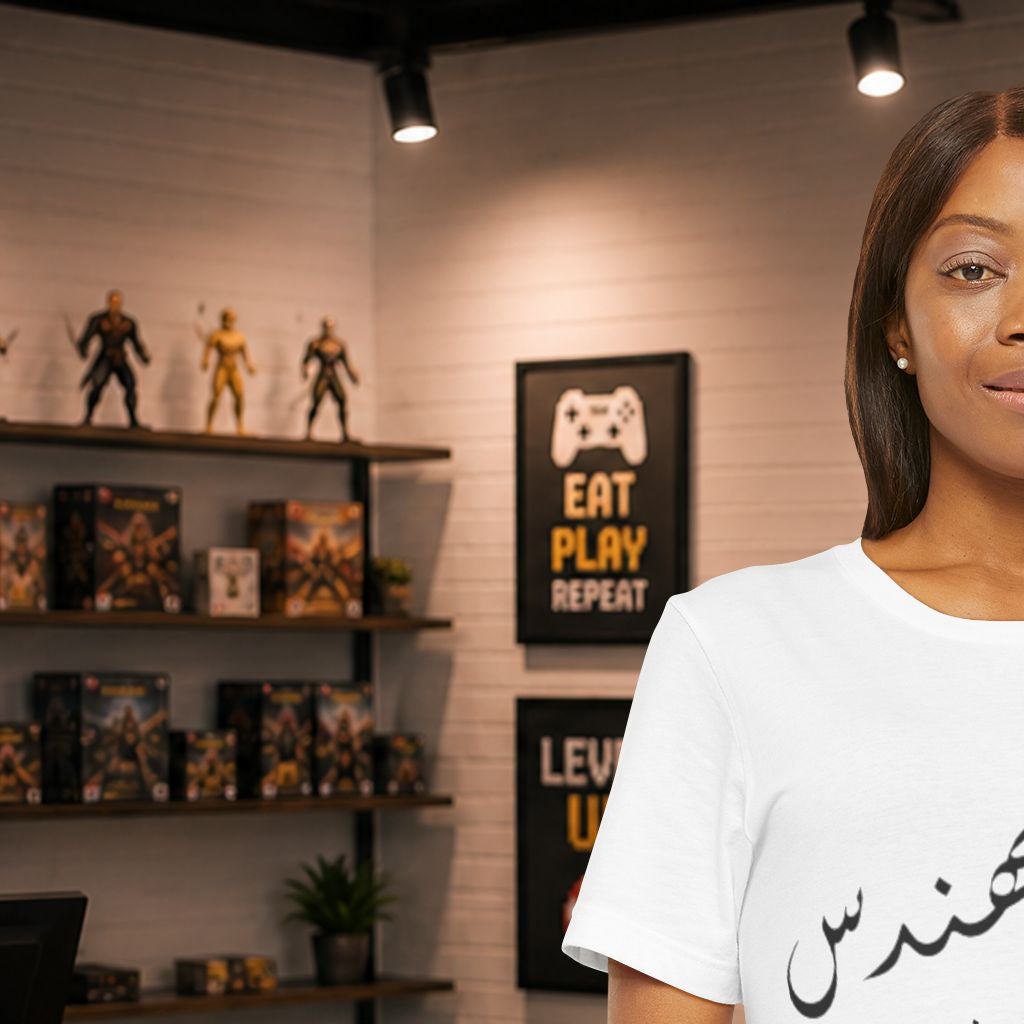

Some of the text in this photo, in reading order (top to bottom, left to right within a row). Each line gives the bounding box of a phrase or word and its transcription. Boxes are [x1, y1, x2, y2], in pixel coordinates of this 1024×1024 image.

[564, 471, 636, 519] EAT
[551, 526, 647, 573] PLAY
[551, 579, 648, 612] REPEAT
[540, 736, 624, 787] LEV
[566, 793, 609, 852] U
